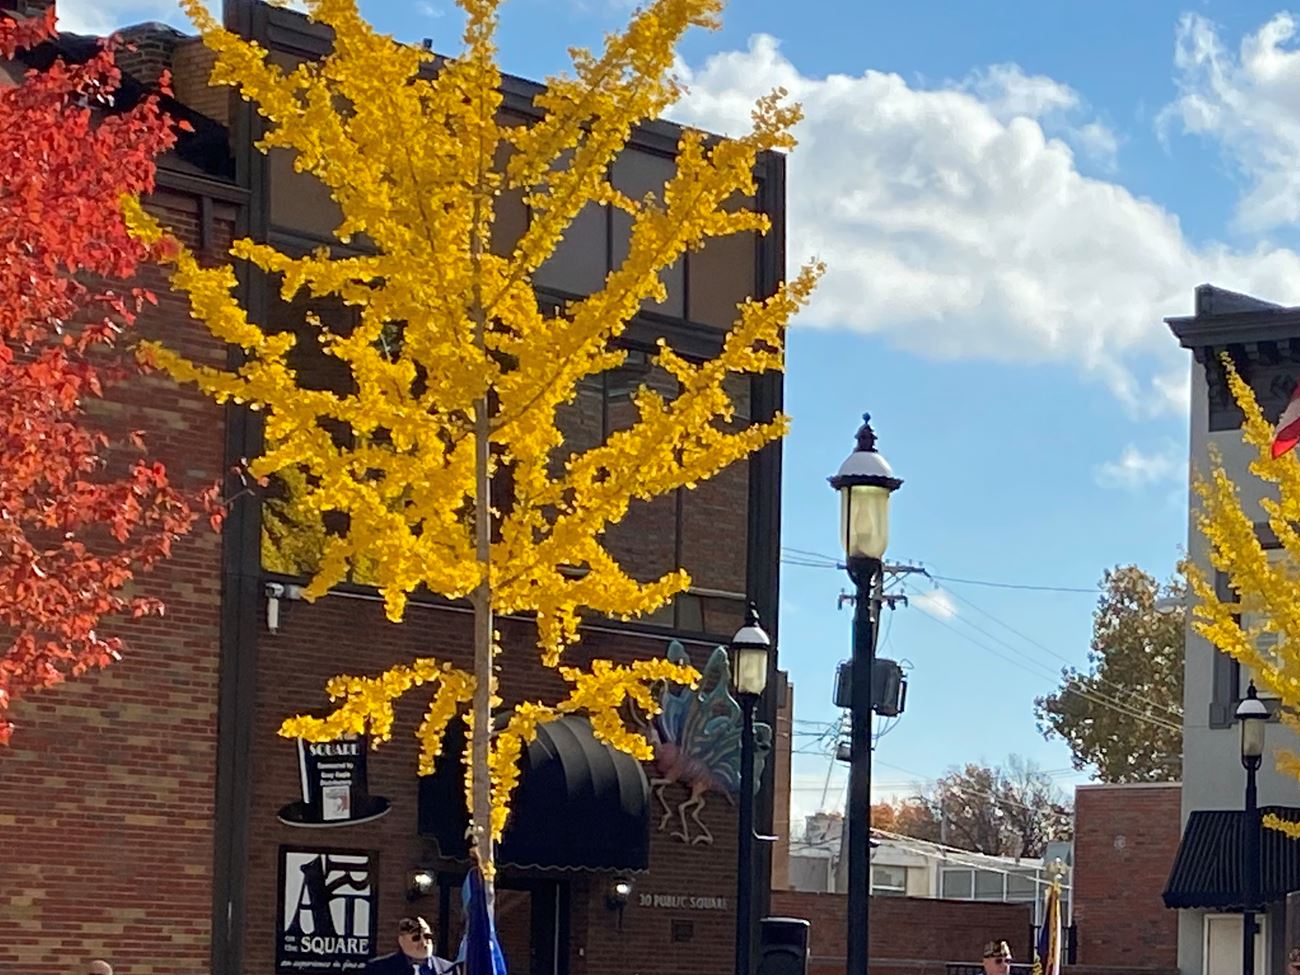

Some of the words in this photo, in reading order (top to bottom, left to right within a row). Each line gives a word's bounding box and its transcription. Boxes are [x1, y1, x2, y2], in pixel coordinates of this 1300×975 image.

[309, 743, 359, 756] SQUARE
[639, 893, 652, 907] 30
[653, 894, 688, 908] PUBLIC
[689, 896, 728, 910] SQUARE
[301, 936, 370, 956] SQUARE
